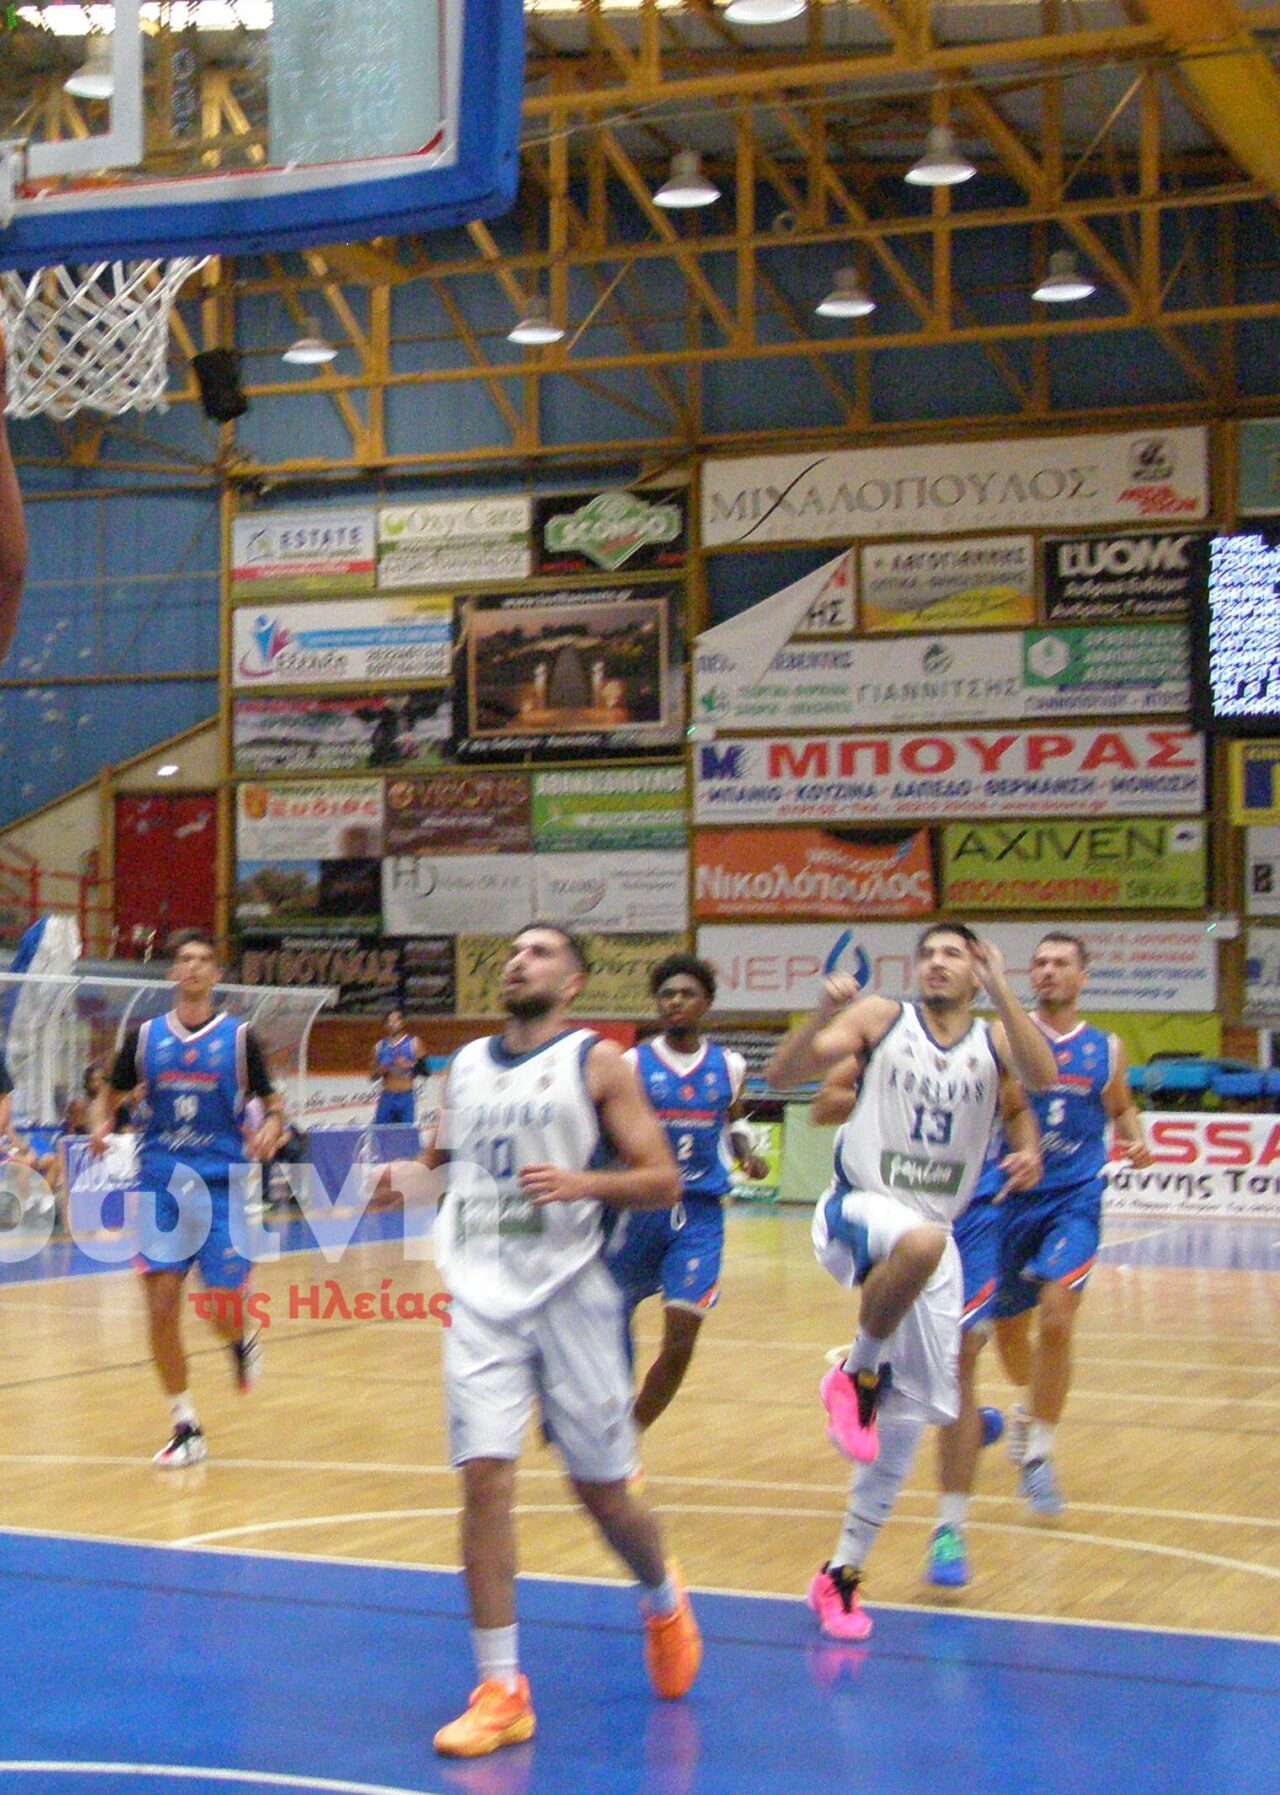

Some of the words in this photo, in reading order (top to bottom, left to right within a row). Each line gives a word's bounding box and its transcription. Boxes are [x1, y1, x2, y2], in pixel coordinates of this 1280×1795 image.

[279, 526, 363, 550] ESTATE
[768, 731, 1197, 779] ΜΠΟΥΡΑΣ
[952, 827, 1166, 862] AXIVEN
[694, 862, 933, 905] Νικολόπουλος
